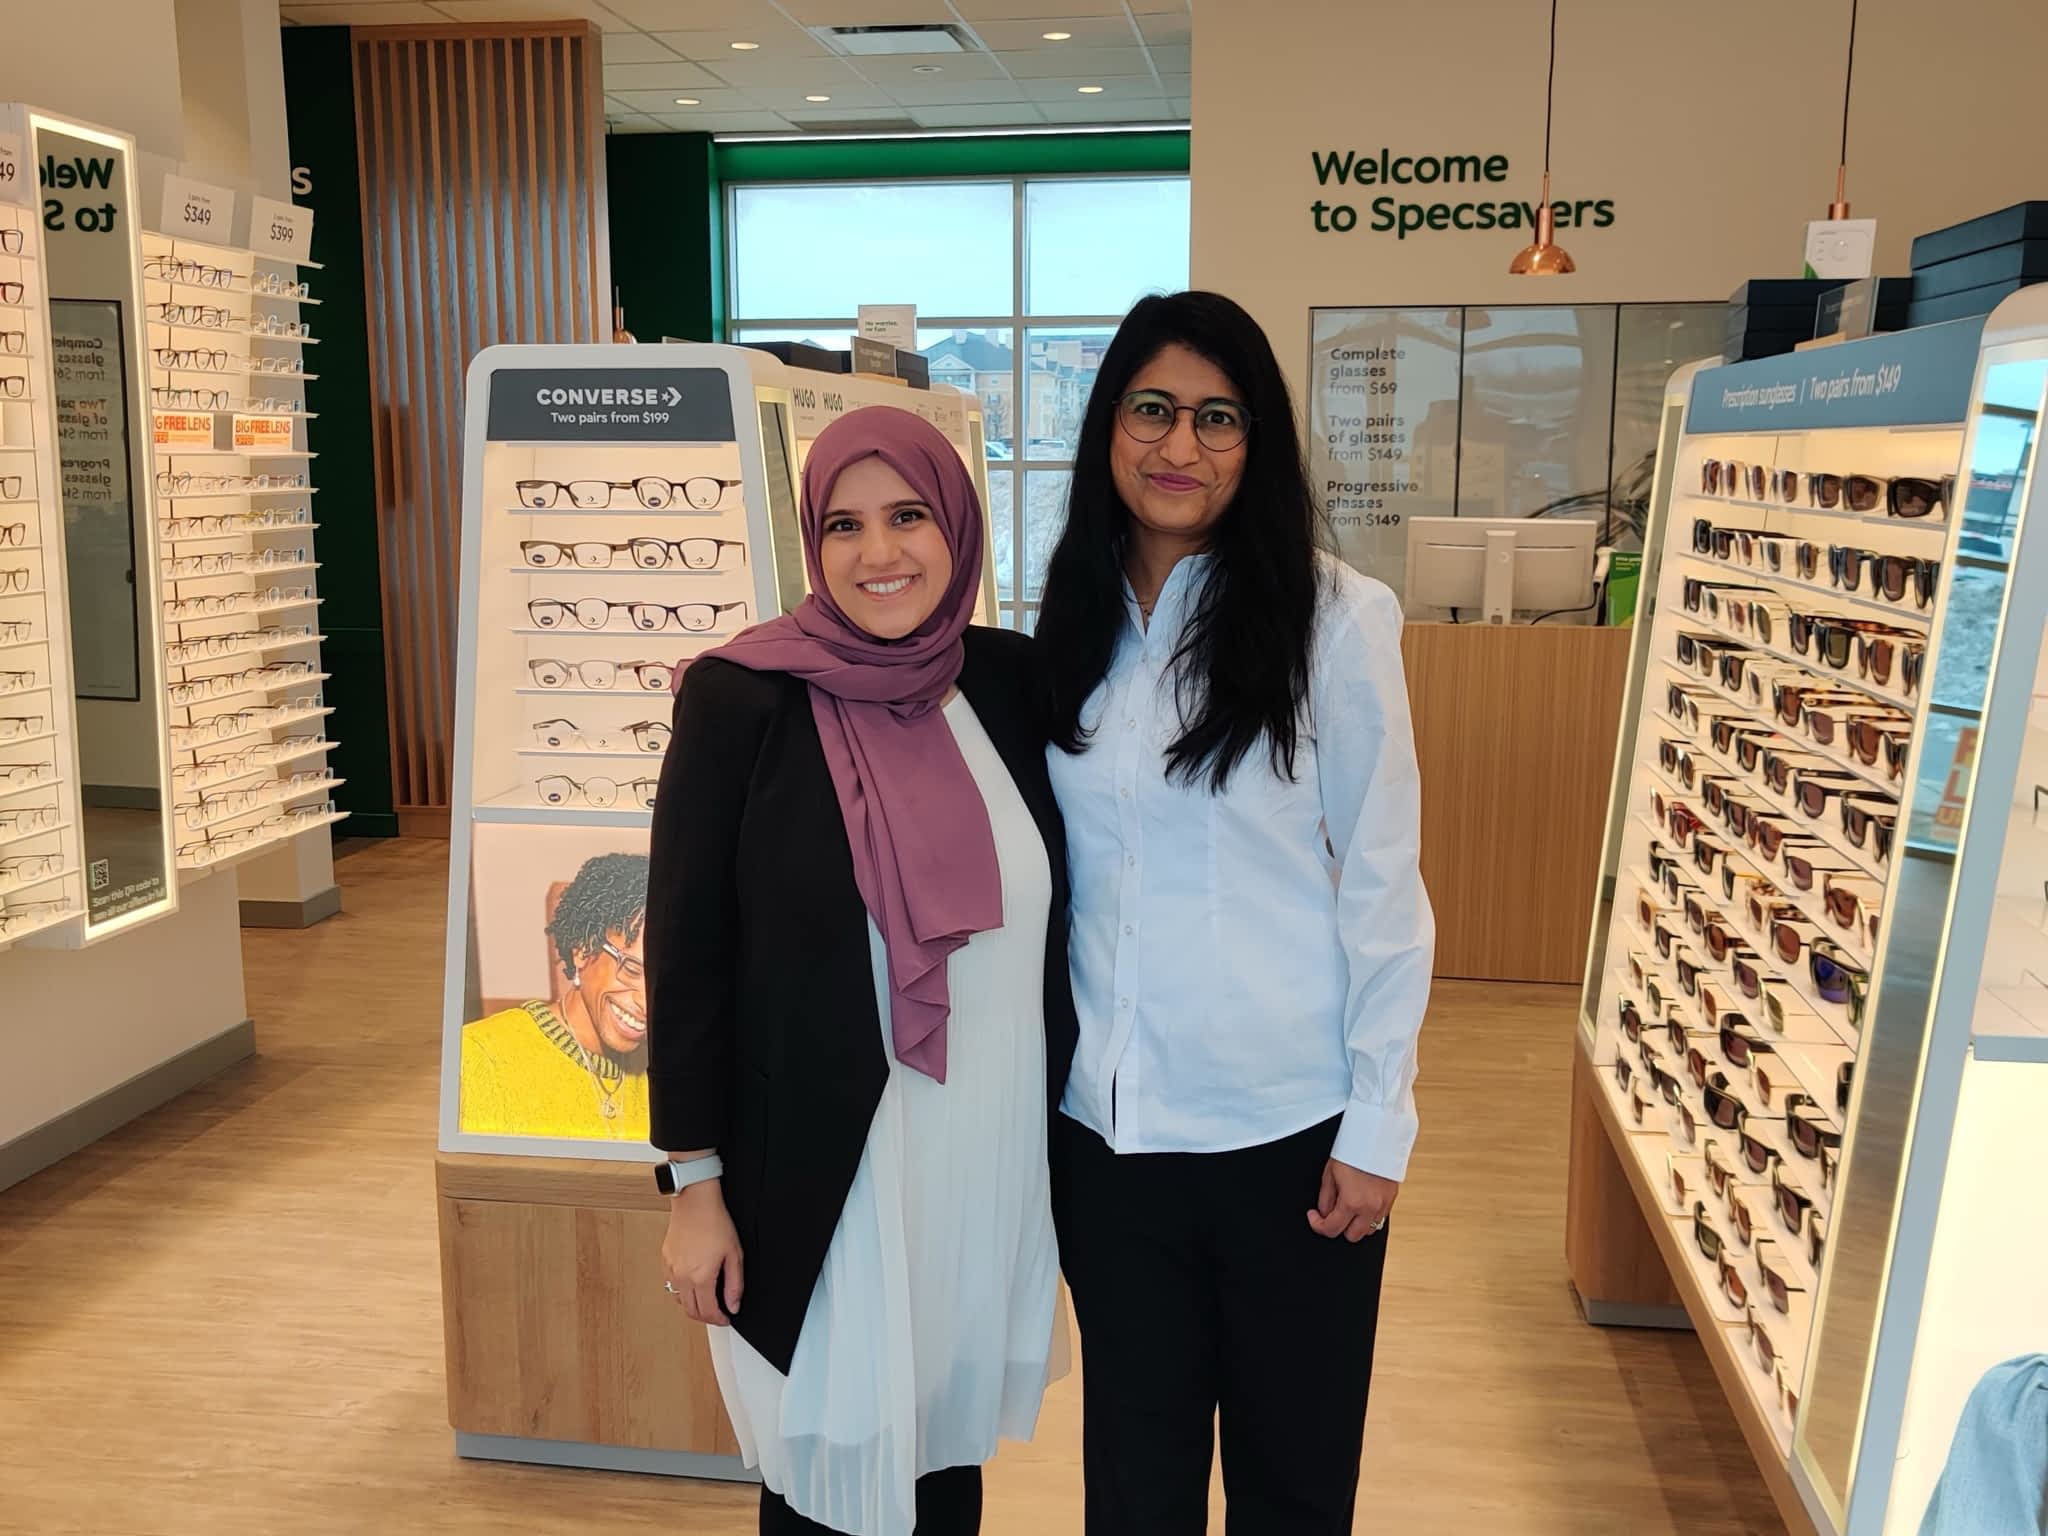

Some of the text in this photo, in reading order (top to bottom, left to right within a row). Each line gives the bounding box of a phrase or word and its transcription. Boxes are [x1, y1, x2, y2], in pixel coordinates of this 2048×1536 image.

[1311, 148, 1509, 185] Welcome
[184, 202, 212, 225] $349
[1311, 197, 1615, 240] to Specsavers
[270, 223, 294, 244] $399
[1330, 347, 1406, 362] Complete
[1330, 365, 1386, 380] glasses
[1330, 381, 1398, 395] from $69
[1721, 362, 1902, 412] Prescription sunglasses Two pairs from $149
[536, 388, 658, 406] CONVERSE
[793, 387, 815, 408] HUGO
[823, 391, 843, 411] HUGO
[164, 416, 186, 430] FREE
[188, 416, 211, 431] LENS
[551, 411, 670, 426] Two pairs from $199
[1329, 413, 1405, 428] Two pairs
[235, 420, 291, 433] BIG FREE LENS
[1329, 430, 1406, 446] of glasses
[1329, 447, 1403, 461] from $149
[1327, 480, 1418, 495] Progressive
[1327, 497, 1383, 512] glasses
[1328, 512, 1400, 527] from $149
